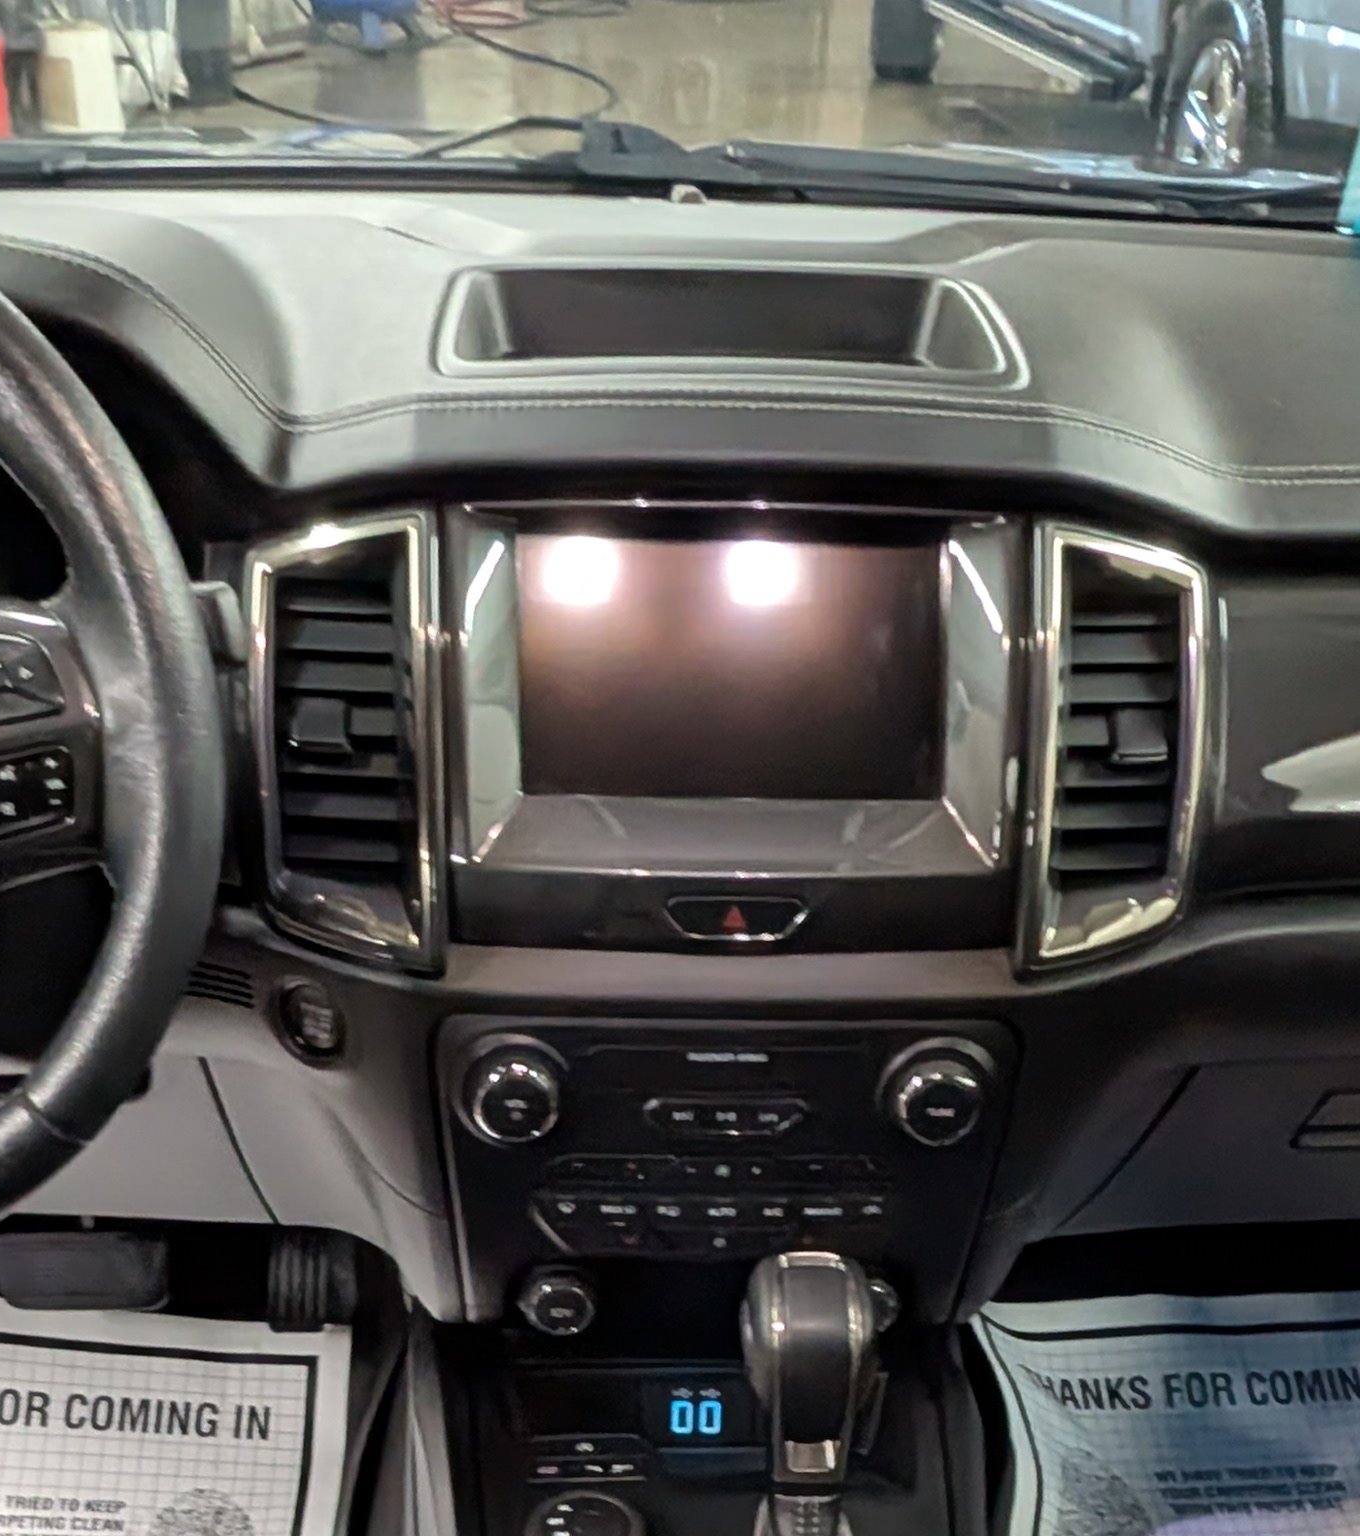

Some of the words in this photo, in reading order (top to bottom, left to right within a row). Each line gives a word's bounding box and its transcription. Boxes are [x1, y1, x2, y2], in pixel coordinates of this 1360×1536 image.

[1163, 1371, 1238, 1408] FOR
[64, 1393, 221, 1439] COMING
[232, 1404, 272, 1441] IN
[5, 1494, 54, 1511] TRIED
[59, 1497, 80, 1513] TO
[85, 1499, 128, 1514] KEEP
[70, 1516, 125, 1532] CLEAN
